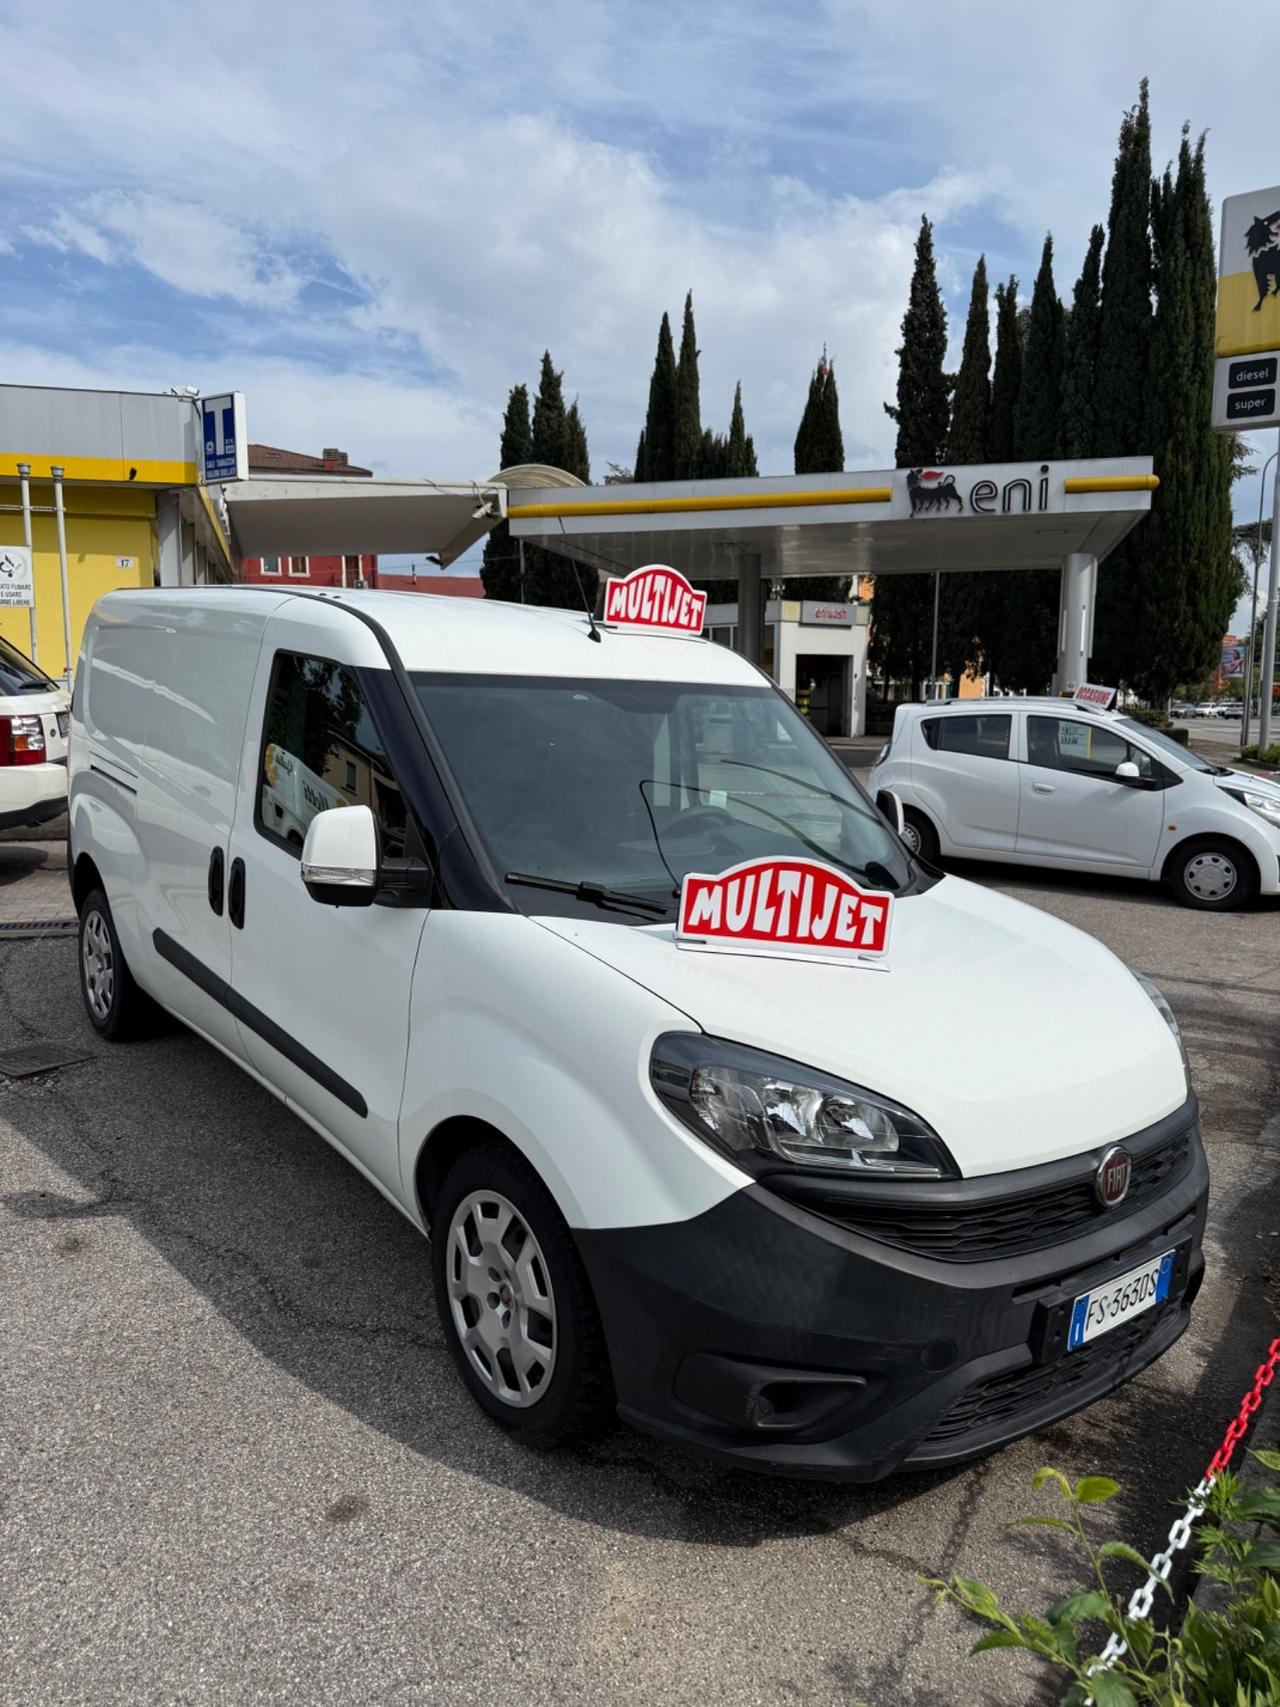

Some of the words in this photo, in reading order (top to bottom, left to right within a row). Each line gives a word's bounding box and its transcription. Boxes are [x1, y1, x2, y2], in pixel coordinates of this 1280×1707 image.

[1236, 367, 1269, 381] diesel
[1234, 398, 1266, 411] super
[205, 395, 232, 456] T
[970, 464, 1049, 513] eni
[121, 559, 130, 568] 17
[609, 573, 703, 628] MULTIJET
[688, 868, 884, 945] MULTIJET
[1107, 1163, 1127, 1194] FIAT
